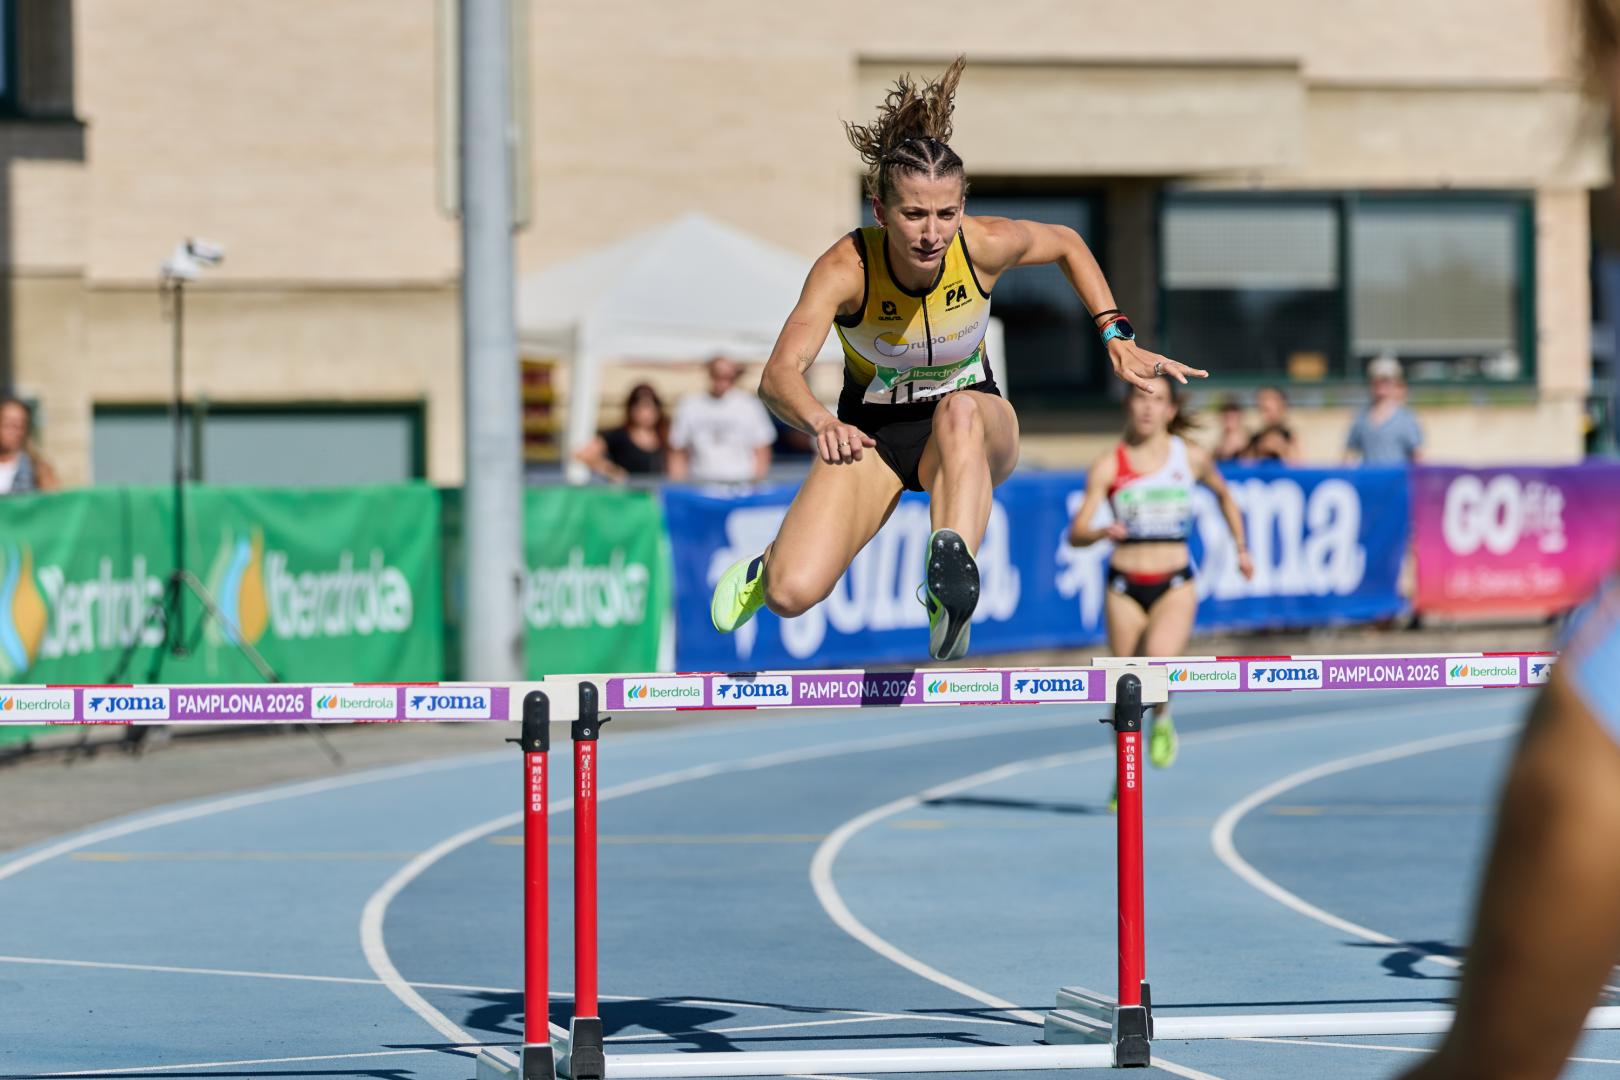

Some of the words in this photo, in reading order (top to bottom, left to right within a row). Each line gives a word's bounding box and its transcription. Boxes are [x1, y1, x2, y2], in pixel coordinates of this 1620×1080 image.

[946, 284, 967, 306] PA
[956, 373, 977, 389] PA
[1189, 670, 1237, 681] Iberdrola
[1329, 665, 1405, 683] PAMPLONA
[1406, 664, 1439, 681] 2026
[1470, 665, 1517, 677] Iberdrola
[650, 686, 700, 698] Iberdrola
[799, 681, 879, 699] PAMPLONA
[882, 680, 917, 697] 2026
[950, 681, 999, 693] Iberdrola
[16, 699, 71, 711] Iberdrola
[177, 694, 264, 714] PAMPLONA
[266, 694, 305, 713] 2026
[340, 697, 394, 709] Iberdrola
